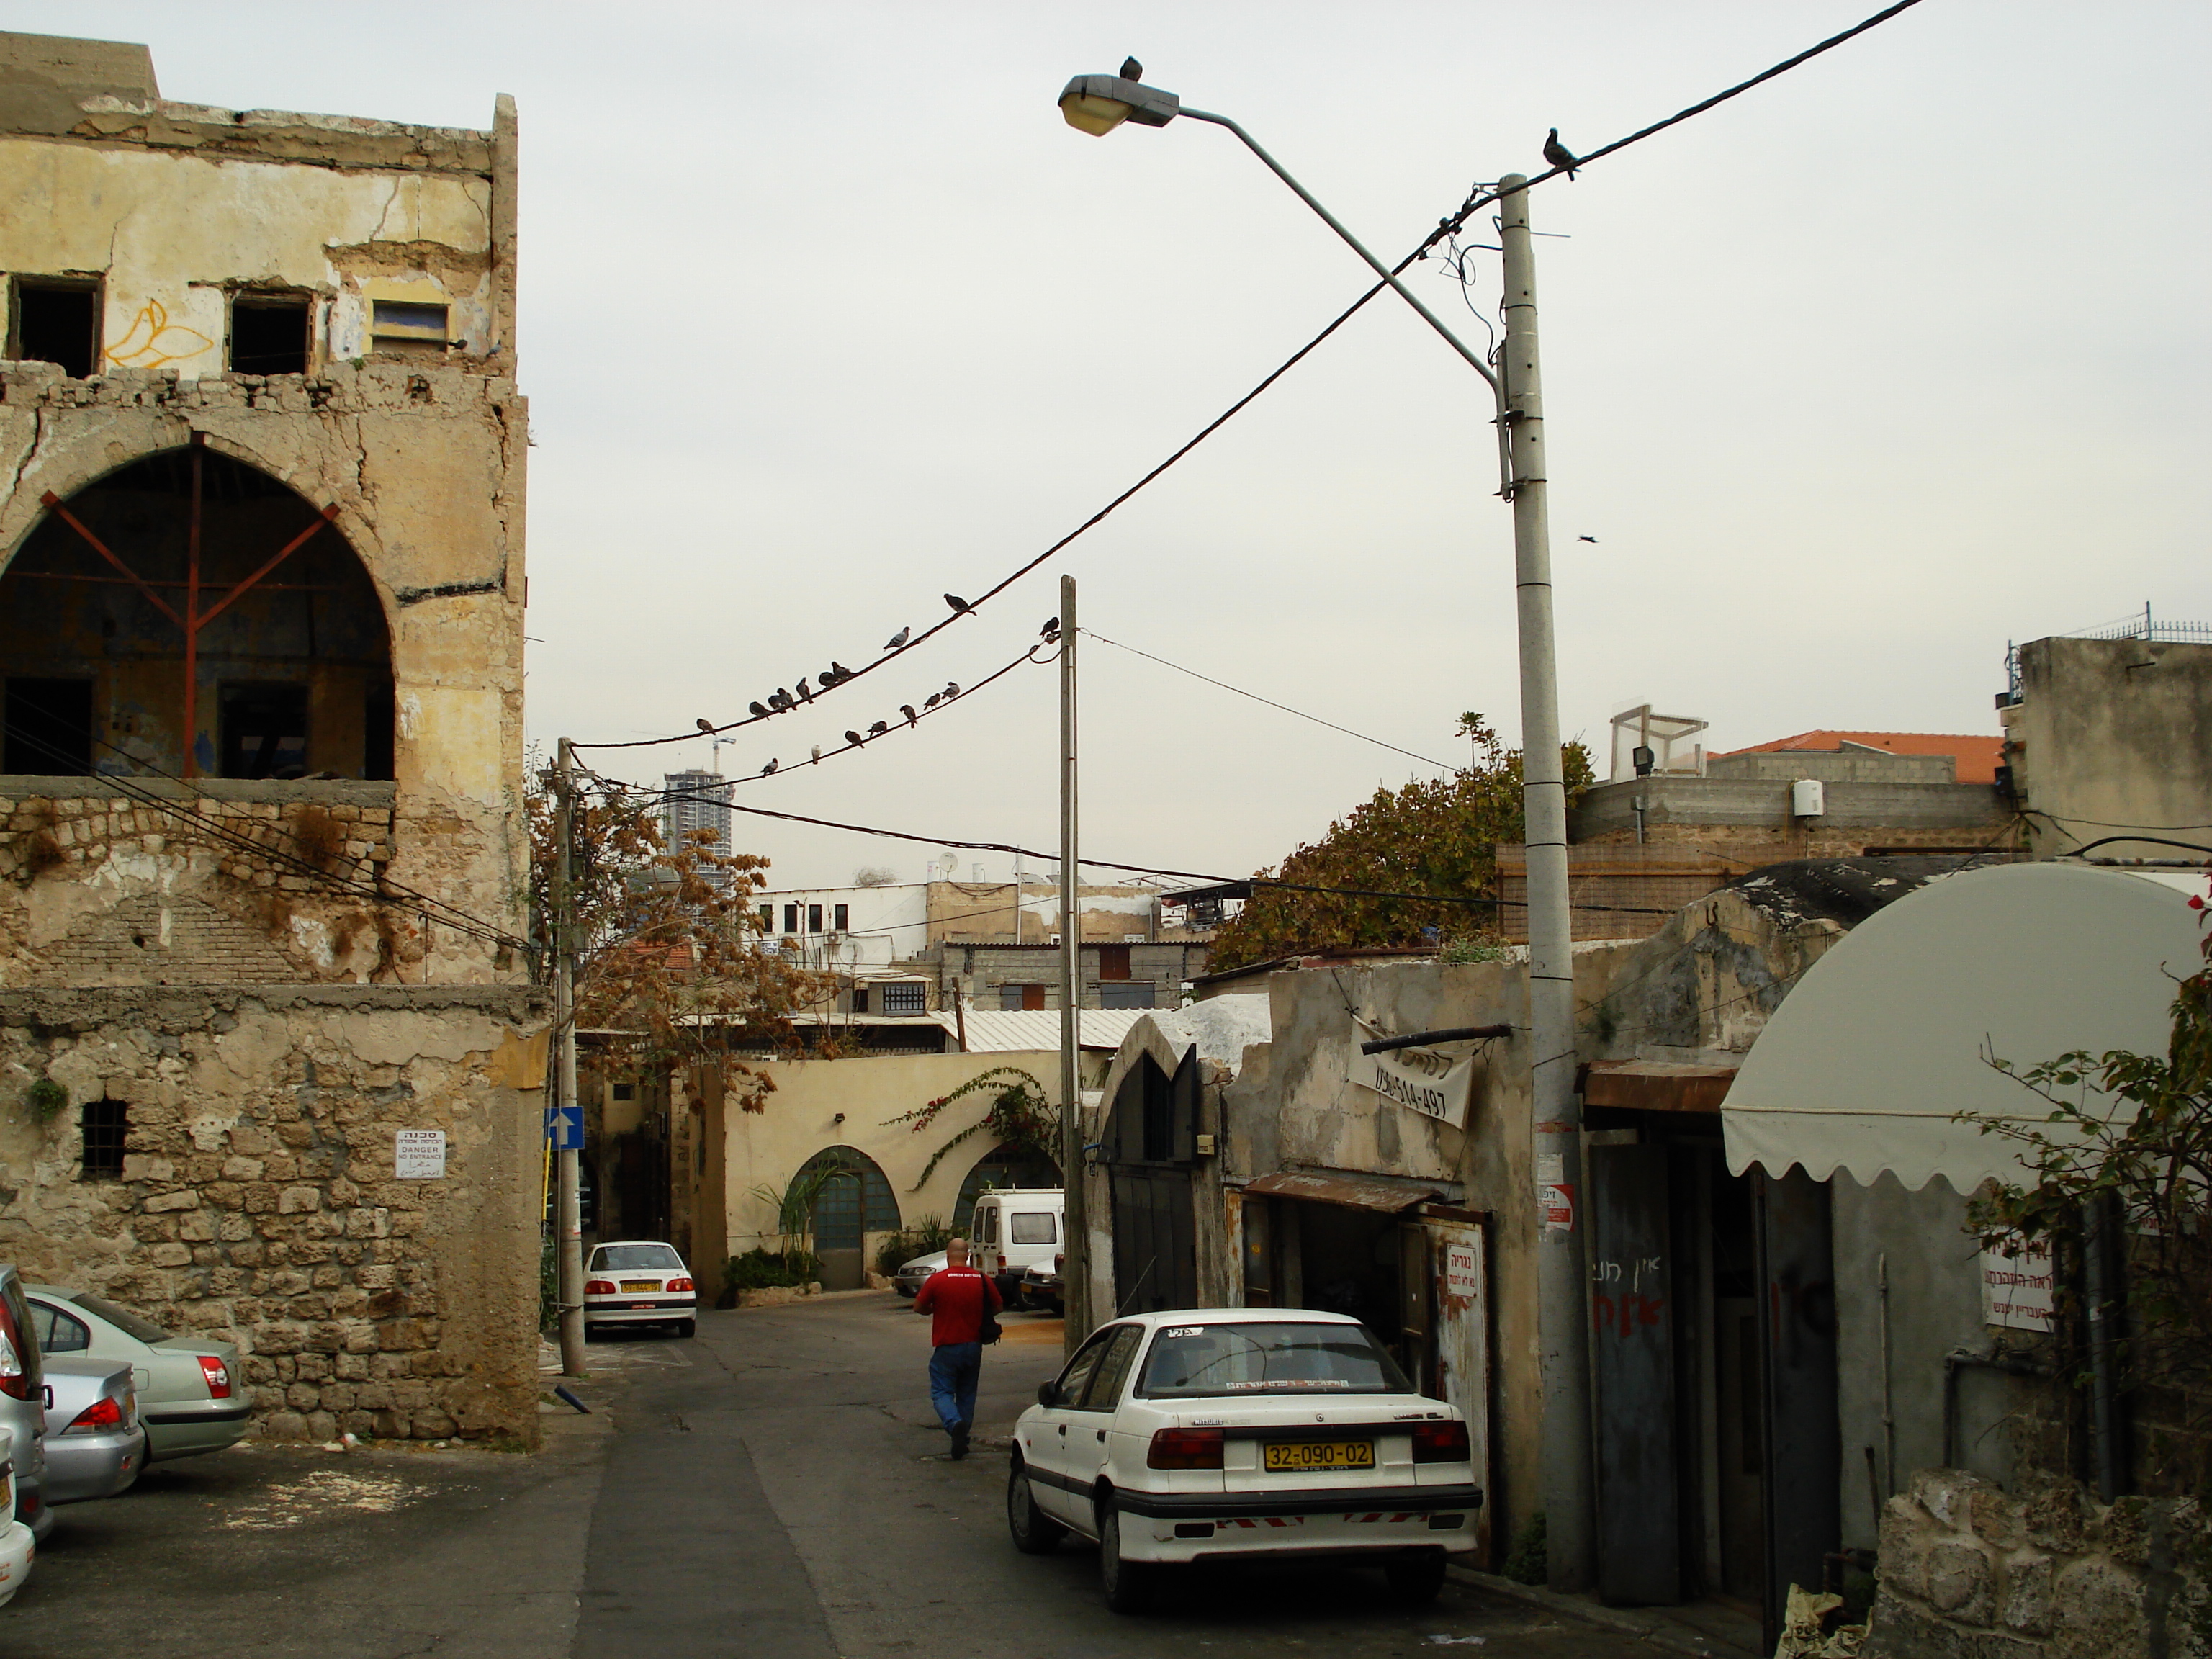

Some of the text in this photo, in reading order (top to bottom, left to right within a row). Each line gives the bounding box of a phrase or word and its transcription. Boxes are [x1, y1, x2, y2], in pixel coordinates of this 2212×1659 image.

[1451, 1254, 1471, 1269] נגריה
[1633, 1255, 1661, 1293] אין
[1619, 1292, 1665, 1337] אין
[1269, 1444, 1368, 1465] 32-090-02
